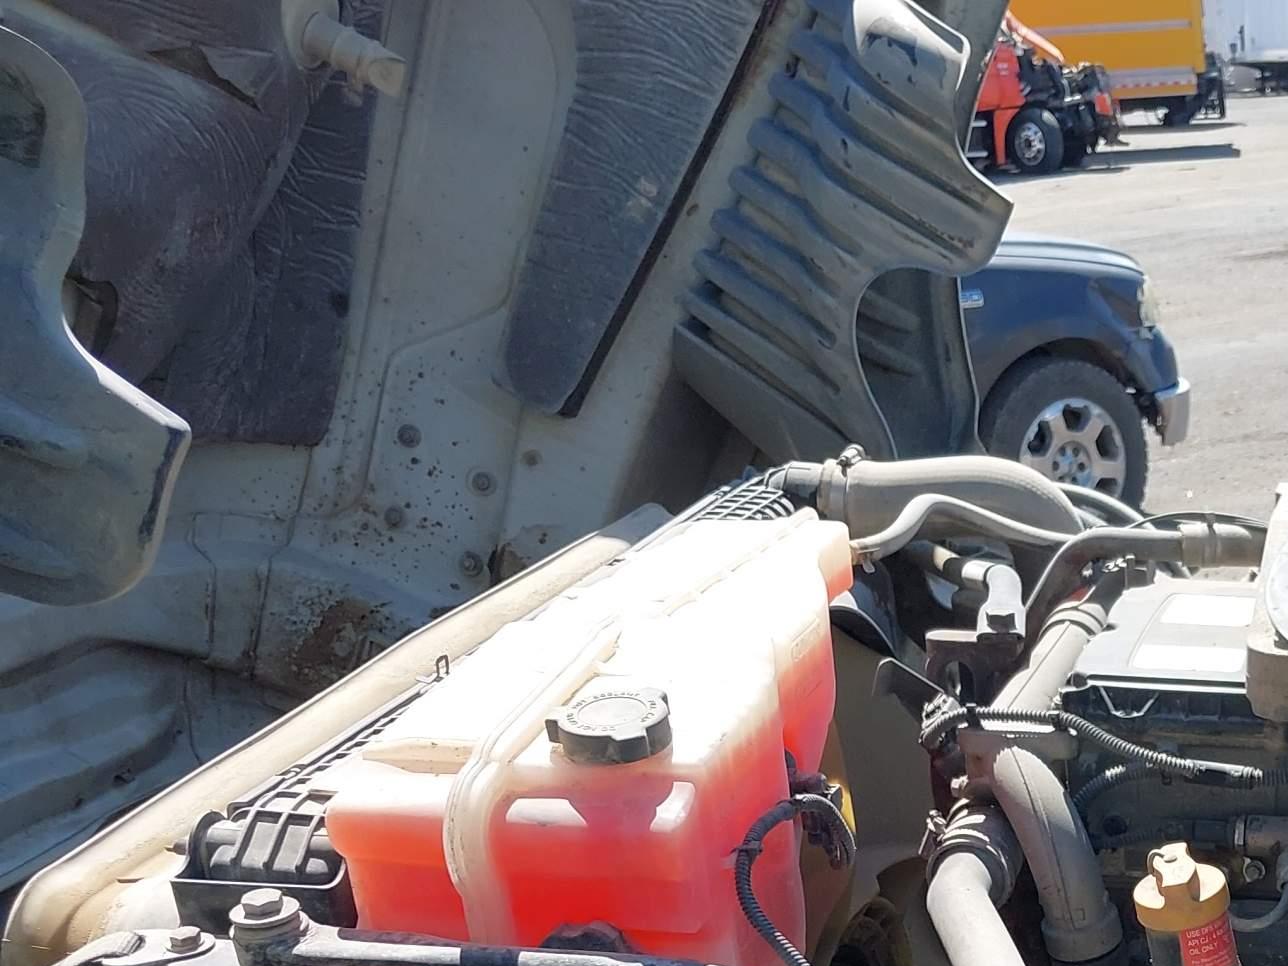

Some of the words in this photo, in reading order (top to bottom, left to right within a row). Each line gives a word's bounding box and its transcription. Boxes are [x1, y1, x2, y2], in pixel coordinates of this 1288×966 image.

[1186, 930, 1201, 939] USE
[1189, 948, 1201, 956] OIL
[1201, 942, 1218, 953] ONLY
